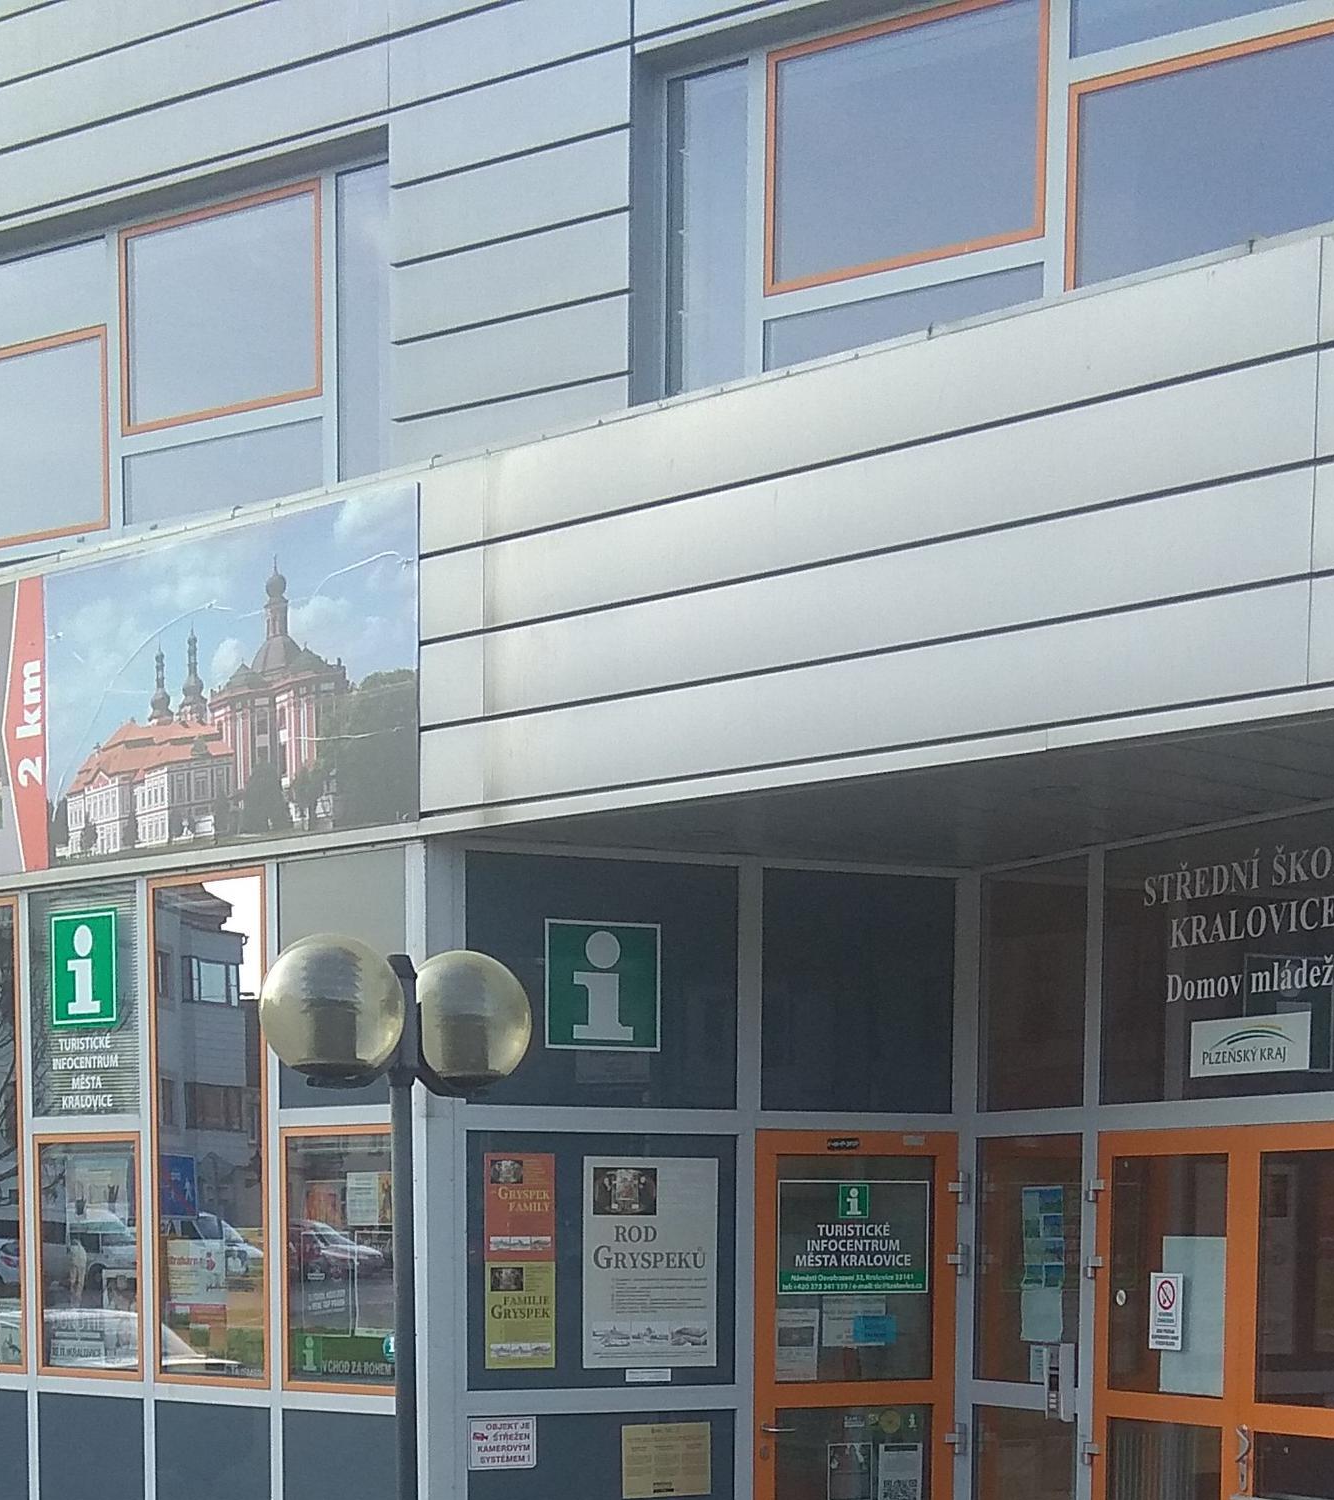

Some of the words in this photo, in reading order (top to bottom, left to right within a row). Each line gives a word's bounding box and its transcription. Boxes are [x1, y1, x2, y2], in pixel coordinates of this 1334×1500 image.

[16, 659, 43, 739] km
[17, 755, 43, 787] 2
[1143, 848, 1261, 907] STŘEDNÍ
[1165, 972, 1244, 1003] Domov
[58, 1033, 111, 1051] TURISTICKÉ
[52, 1054, 119, 1070] INFOCENTRUM
[1202, 1047, 1258, 1066] PLZEŇSKÝ
[1260, 1047, 1287, 1064] KRAJ
[72, 1074, 103, 1090] MĚSTA
[61, 1094, 113, 1110] KRALOVICE
[508, 1201, 551, 1212] FAMILY
[614, 1225, 658, 1243] ROD
[817, 1222, 891, 1237] TURISTICKÉ
[806, 1239, 900, 1252] INFOCENTRUM
[795, 1252, 838, 1267] MĚSTA
[840, 1253, 912, 1267] KRALOVICE
[350, 1360, 364, 1375] ZA
[485, 1422, 518, 1431] OBJEKT
[520, 1422, 531, 1430] JE
[492, 1431, 531, 1442] STŘEŽEN
[477, 1442, 531, 1454] KAMEROVÝM
[480, 1453, 526, 1465] SYSTÉMEM
